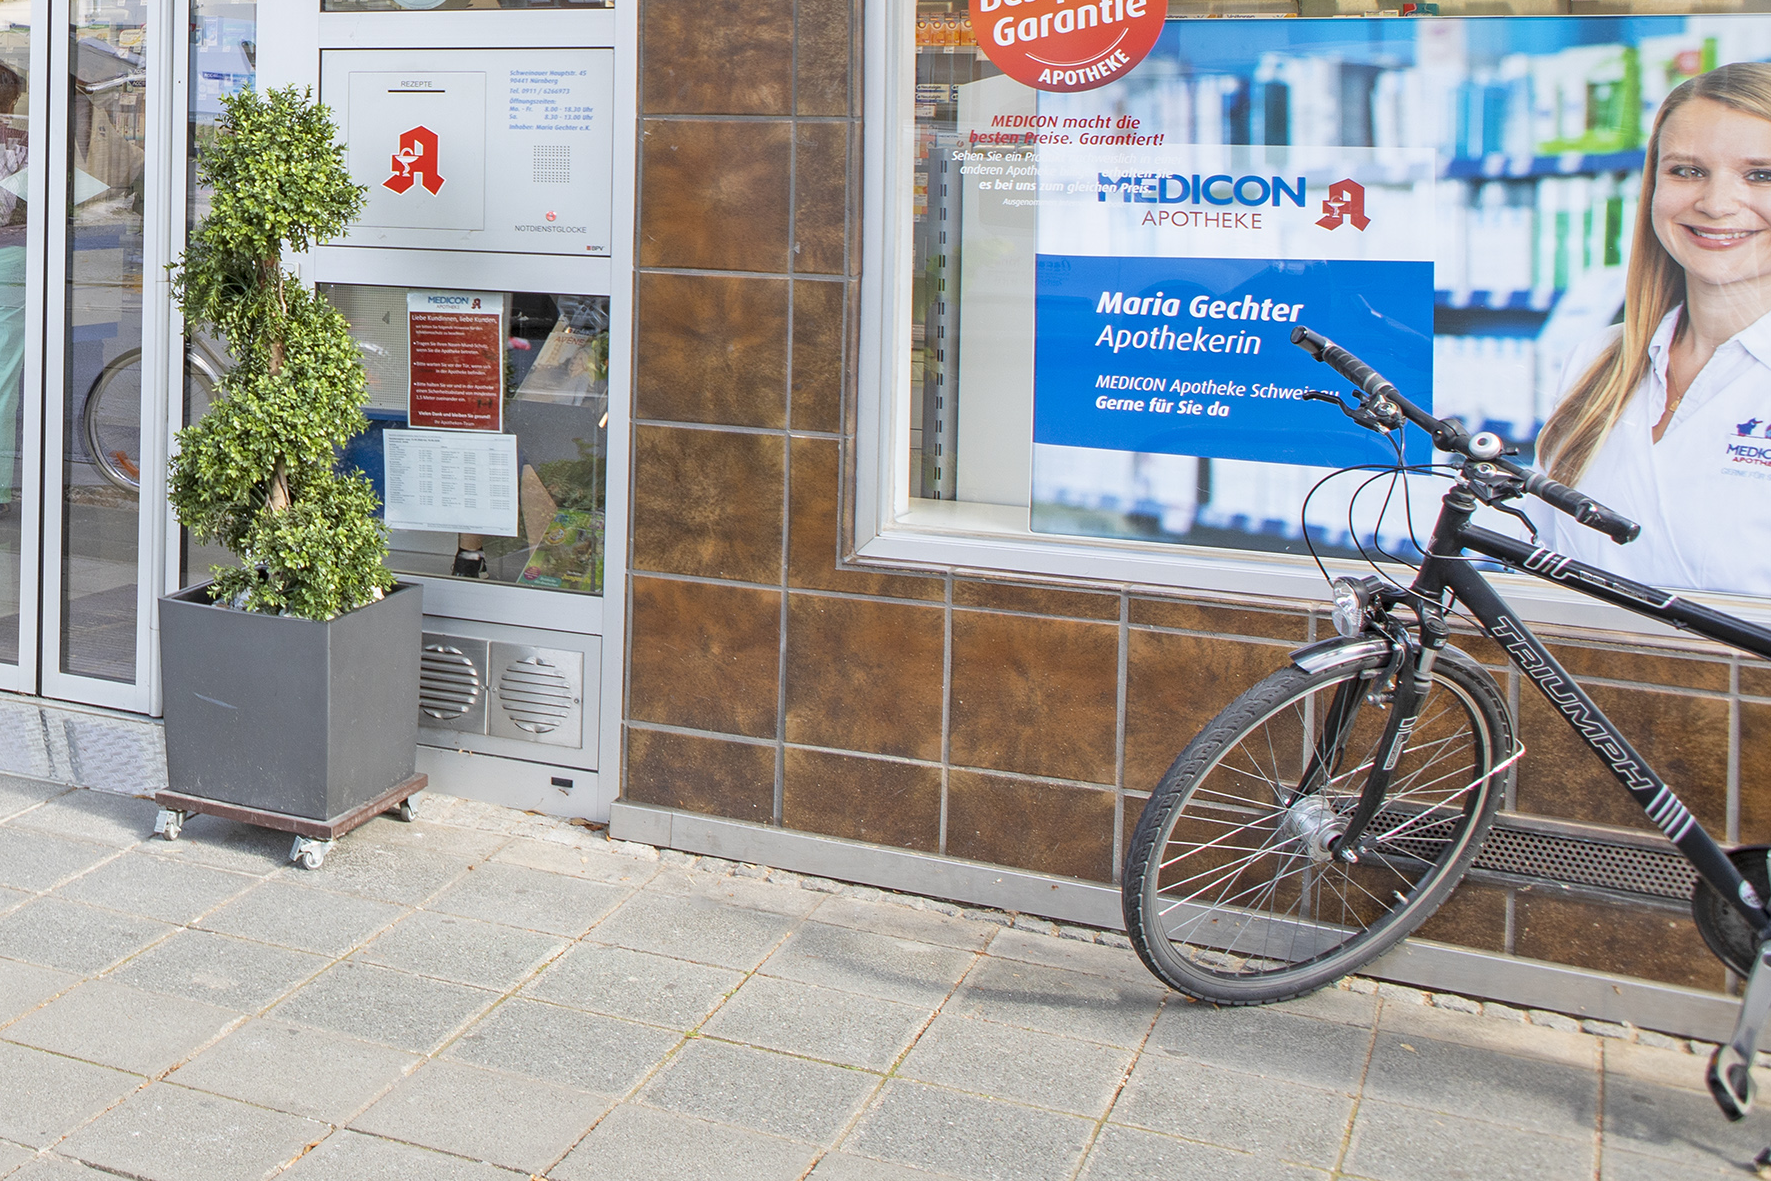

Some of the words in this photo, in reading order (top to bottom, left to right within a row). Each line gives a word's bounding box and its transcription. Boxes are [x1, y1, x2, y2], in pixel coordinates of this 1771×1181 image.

[1038, 48, 1131, 87] APOTHEKE
[530, 77, 558, 85] Nürnberg
[509, 97, 556, 105] Öffnungszeiten:
[991, 115, 1058, 128] MEDICON
[1062, 115, 1114, 128] macht
[1116, 115, 1141, 129] die
[969, 130, 1019, 144] besten
[1024, 131, 1073, 144] Preise.
[1079, 132, 1165, 146] Garantiert!
[951, 150, 984, 161] Sehen
[986, 151, 1002, 162] Sie
[1005, 151, 1021, 162] ein
[960, 165, 1003, 175] anderen
[978, 181, 991, 190] es
[994, 179, 1013, 191] bei
[1015, 181, 1036, 191] uns
[1039, 182, 1065, 192] zum
[1066, 180, 1117, 194] gleichen
[1120, 182, 1152, 194] Preis.
[1097, 172, 1306, 208] MEDICON
[1141, 210, 1262, 230] APOTHEKE
[514, 225, 587, 234] NOTDIENSTGLOCKE
[428, 296, 469, 305] MEDICON
[1096, 291, 1181, 318] Maria
[1189, 294, 1304, 322] Gechter
[1095, 324, 1262, 355] Apothekerin
[1095, 375, 1166, 392] MEDICON
[1169, 379, 1246, 399] Apotheke
[1250, 383, 1340, 401] Schwei
[1095, 395, 1144, 412] Gerne
[1148, 397, 1175, 413] für
[1177, 399, 1203, 416] Sie
[1207, 400, 1230, 418] da
[1490, 615, 1655, 790] TRIUMPH
